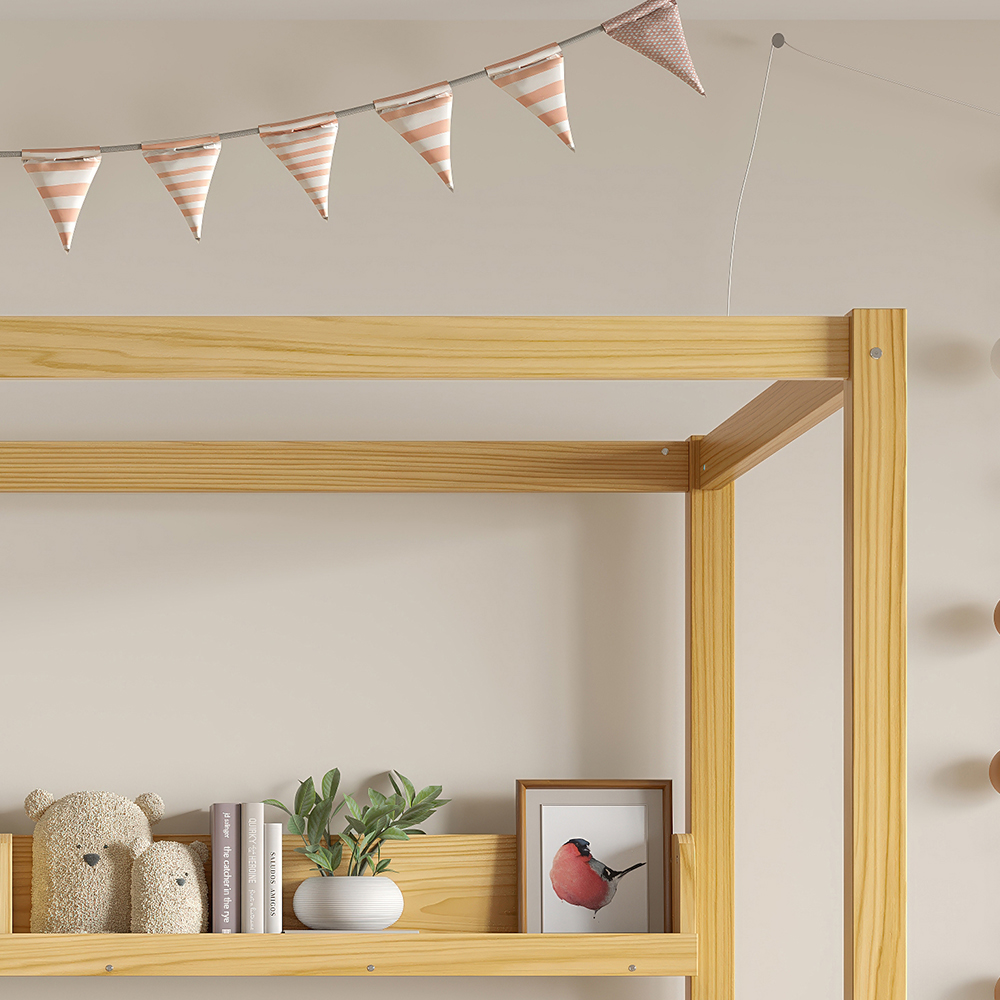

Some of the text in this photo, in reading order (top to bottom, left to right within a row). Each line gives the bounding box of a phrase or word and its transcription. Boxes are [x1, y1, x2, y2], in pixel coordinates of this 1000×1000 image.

[223, 846, 233, 858] the
[223, 859, 233, 887] catcher
[223, 896, 233, 909] the
[221, 910, 231, 923] rye
